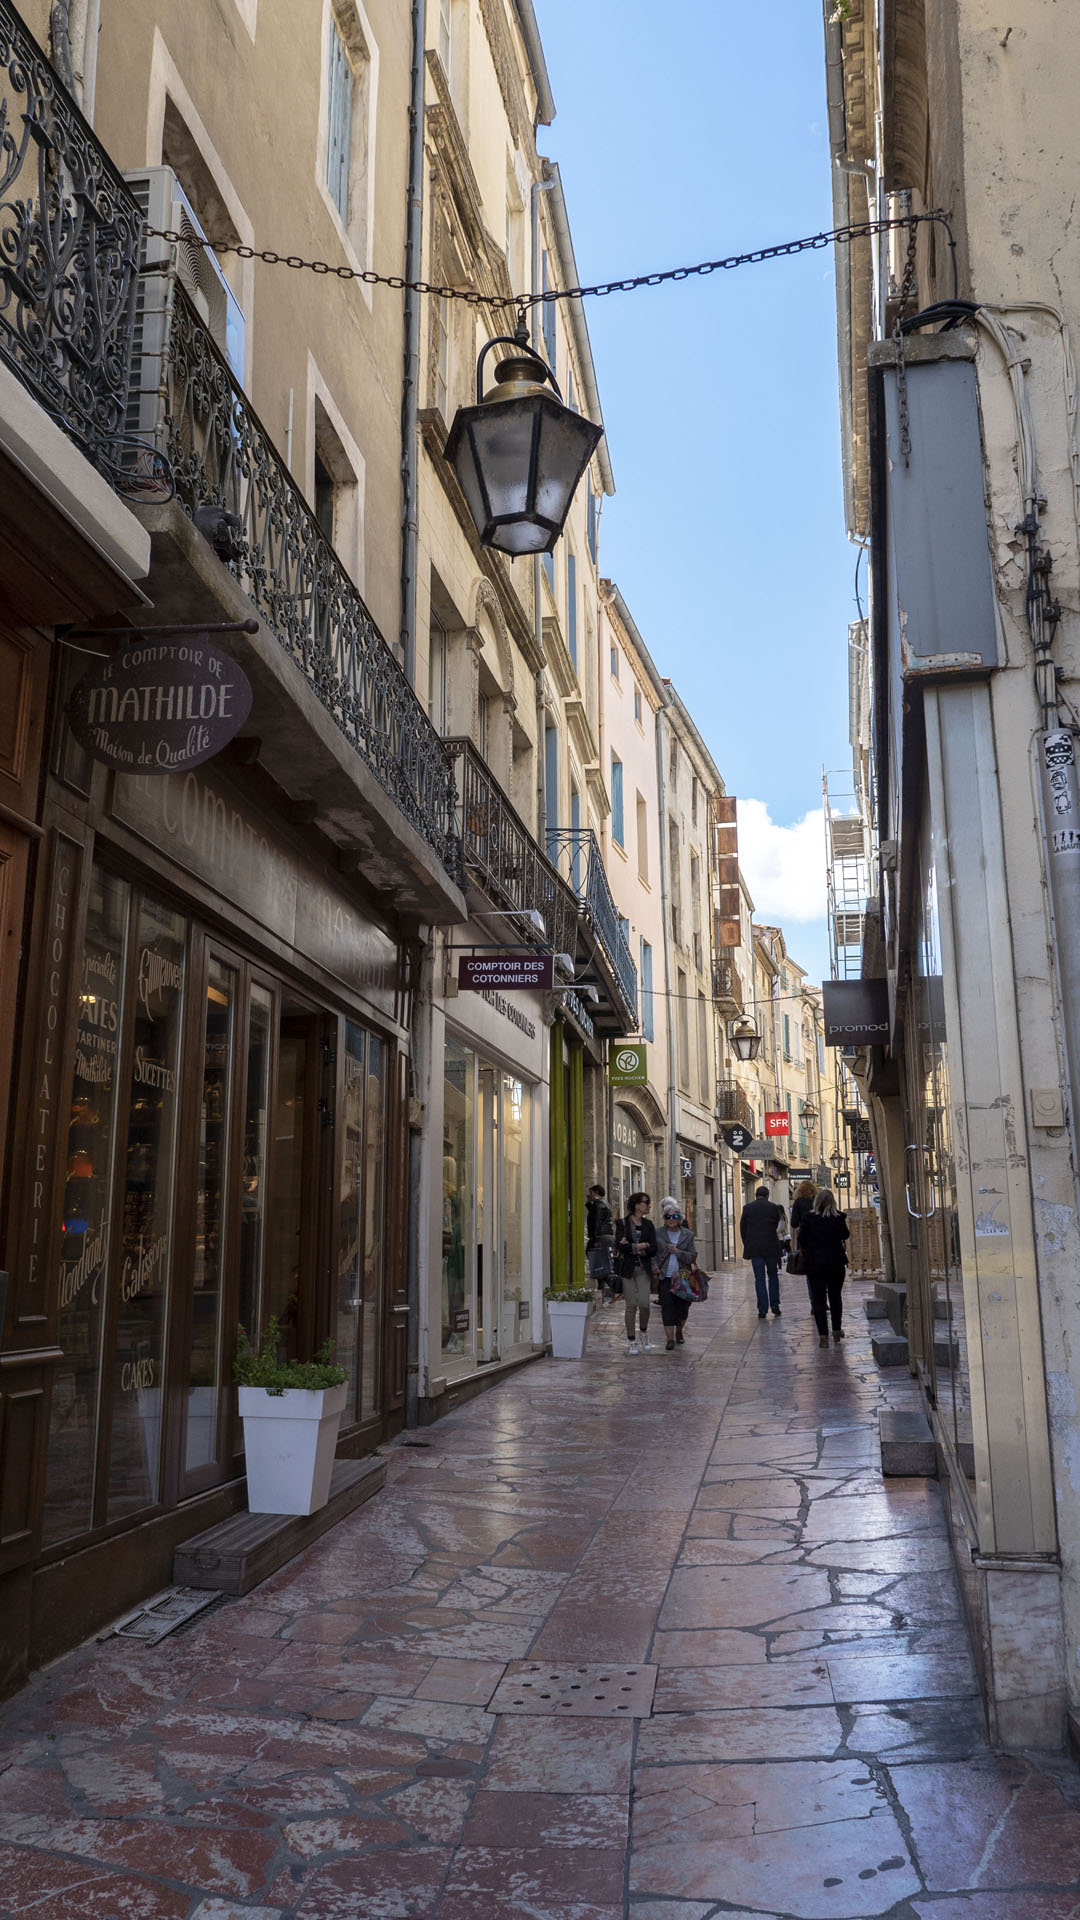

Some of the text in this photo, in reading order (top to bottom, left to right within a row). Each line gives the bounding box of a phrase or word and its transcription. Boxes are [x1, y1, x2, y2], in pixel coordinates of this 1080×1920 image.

[103, 646, 223, 681] LE COMPTOIR DE
[87, 684, 234, 725] MATHILDE
[93, 724, 211, 769] Maison de Qualité
[467, 962, 544, 971] COMPTOIR DES
[472, 974, 538, 983] COTONNIERS
[829, 1021, 889, 1034] promod
[29, 866, 70, 1283] CHOCOLATERIE
[770, 1119, 788, 1128] SFR
[121, 1358, 154, 1392] CAKES
